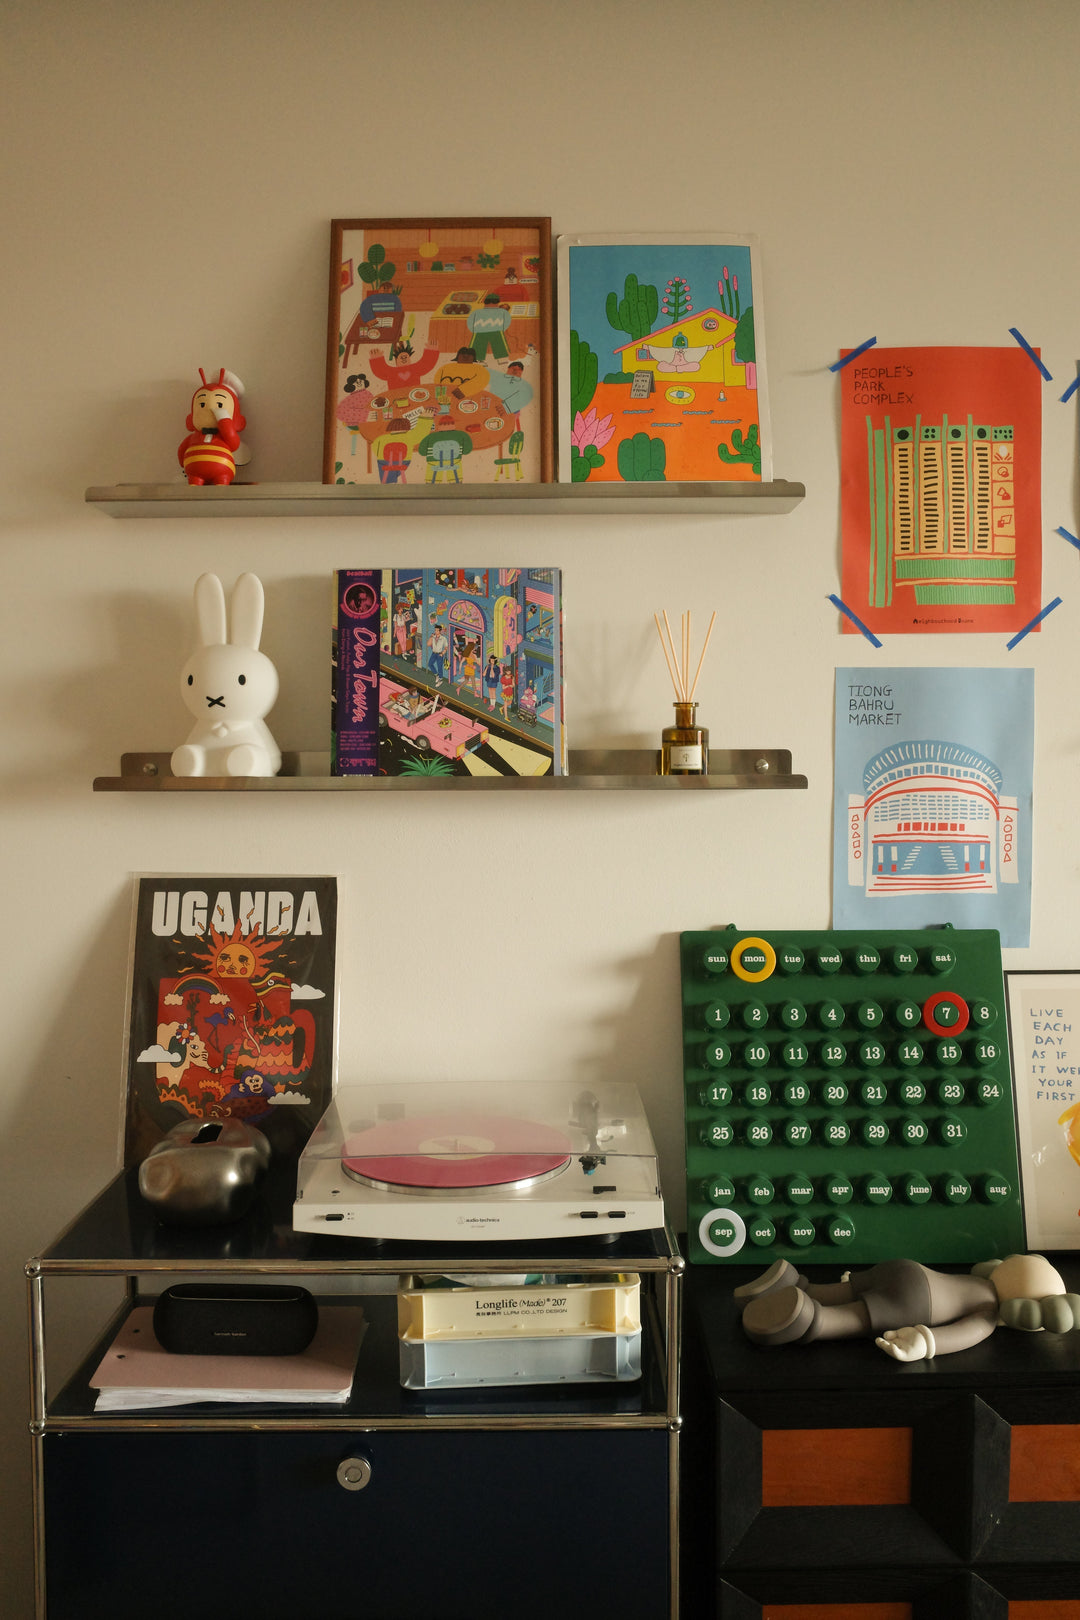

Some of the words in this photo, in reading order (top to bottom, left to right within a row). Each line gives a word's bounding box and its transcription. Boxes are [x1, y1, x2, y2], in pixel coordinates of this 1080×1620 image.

[854, 365, 913, 379] PEOPLE'S
[854, 380, 885, 391] PARK
[853, 392, 914, 405] COMPLEX
[352, 669, 378, 723] Town
[848, 684, 893, 697] TIONG
[848, 698, 894, 711] BAHRU
[848, 713, 902, 726] MARKET
[151, 890, 323, 937] UGANDA
[744, 955, 766, 963] mon
[784, 955, 801, 963] tue
[819, 954, 841, 963] wed
[859, 954, 877, 963] thu
[899, 954, 912, 963] fri
[935, 953, 952, 962] sat
[714, 1009, 722, 1020] 1
[752, 1009, 761, 1020] 2
[790, 1009, 799, 1020] 3
[827, 1009, 837, 1020] 4
[866, 1009, 876, 1020] 5
[904, 1008, 914, 1020] 6
[942, 1008, 951, 1019] 7
[980, 1007, 990, 1019] 8
[1030, 1008, 1063, 1017] LIVE
[1033, 1021, 1072, 1032] EACH
[1035, 1035, 1063, 1045] DAY
[714, 1048, 724, 1060] 9
[750, 1048, 766, 1059] 10
[788, 1048, 804, 1059] 11
[827, 1047, 843, 1059] 12
[865, 1047, 881, 1059] 13
[903, 1047, 920, 1058] 14
[941, 1047, 958, 1058] 15
[980, 1046, 996, 1057] 16
[1031, 1050, 1046, 1059] AS
[1056, 1051, 1067, 1060] IF
[1031, 1065, 1046, 1074] IT
[1038, 1078, 1073, 1087] YOUR
[712, 1088, 728, 1099] 17
[751, 1088, 767, 1100] 18
[790, 1087, 806, 1099] 19
[827, 1087, 845, 1099] 20
[866, 1087, 883, 1098] 21
[905, 1086, 922, 1098] 22
[944, 1085, 961, 1097] 23
[982, 1085, 1000, 1097] 24
[1036, 1091, 1075, 1101] FIRST
[712, 1127, 730, 1139] 25
[751, 1127, 769, 1139] 26
[790, 1127, 808, 1138] 27
[829, 1126, 847, 1138] 28
[868, 1126, 886, 1138] 29
[907, 1125, 925, 1137] 30
[946, 1125, 963, 1137] 31
[713, 1186, 732, 1198] jan
[753, 1187, 770, 1196] feb
[791, 1187, 812, 1195] mar
[831, 1186, 850, 1196] apr
[869, 1186, 891, 1197] may
[910, 1185, 930, 1195] june
[950, 1184, 968, 1196] july
[989, 1186, 1008, 1195] aug
[715, 1228, 733, 1238] sep
[755, 1229, 771, 1237] oct
[793, 1228, 813, 1236] nov
[833, 1228, 851, 1236] dec
[476, 1298, 518, 1311] Longlife
[551, 1297, 567, 1307] 207
